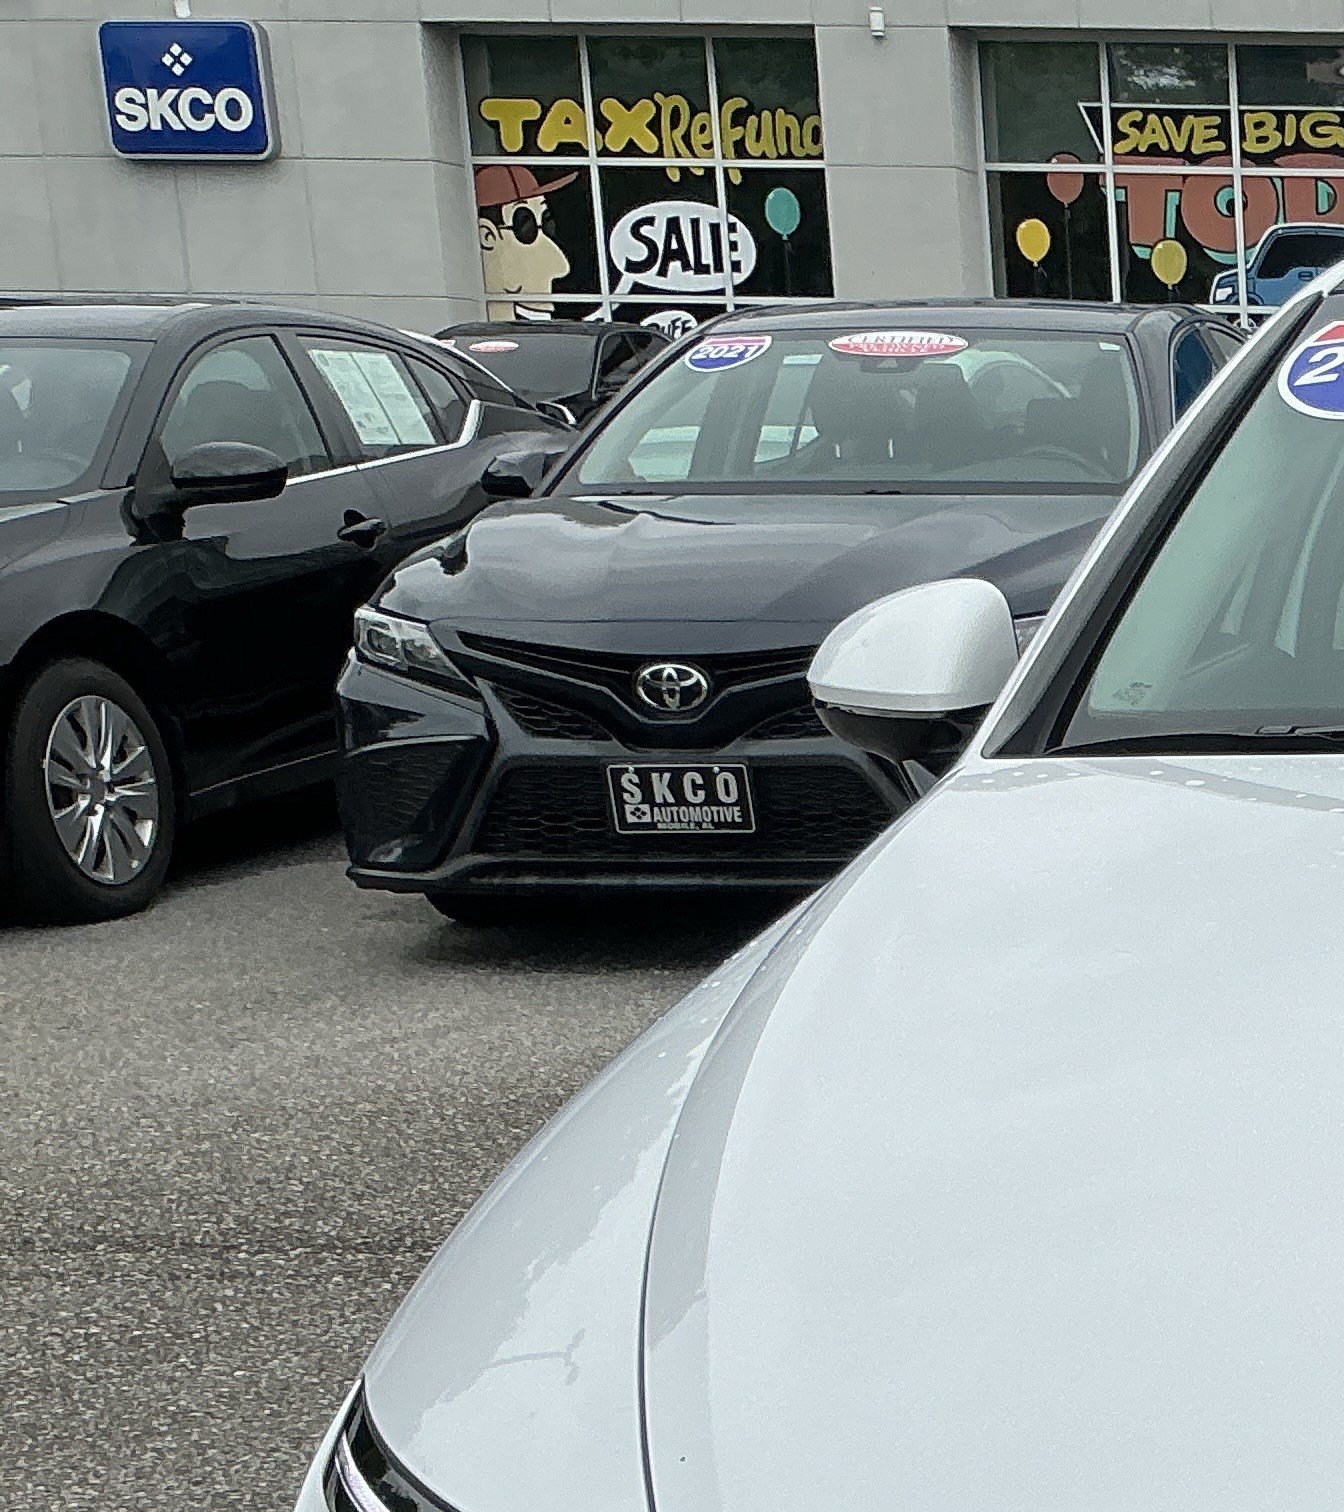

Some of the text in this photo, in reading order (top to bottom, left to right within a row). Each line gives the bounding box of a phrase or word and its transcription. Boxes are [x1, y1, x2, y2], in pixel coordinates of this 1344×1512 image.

[114, 87, 254, 132] SKCO
[480, 98, 659, 153] TAX
[1114, 110, 1226, 156] SAVE
[624, 215, 742, 278] SALE
[653, 805, 743, 823] AUTOMOTIVE
